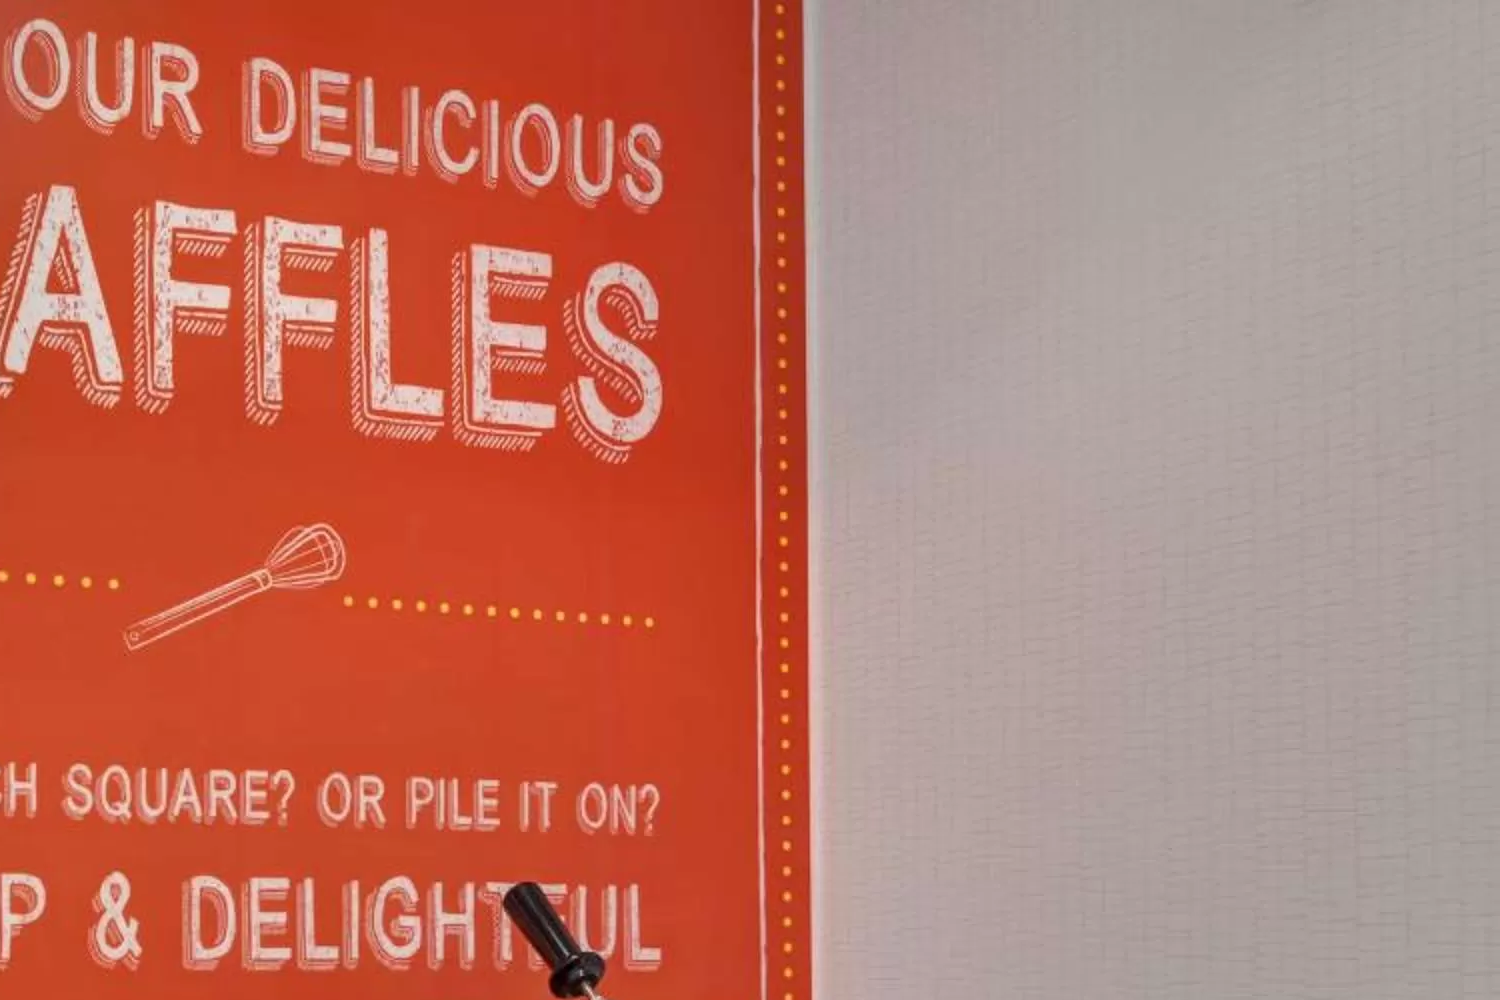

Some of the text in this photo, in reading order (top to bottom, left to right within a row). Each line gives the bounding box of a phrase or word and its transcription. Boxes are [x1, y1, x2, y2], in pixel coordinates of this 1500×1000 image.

[4, 18, 203, 143] OUR
[241, 57, 664, 212] DELICIOUS
[62, 763, 297, 826] SQUARE?
[318, 772, 385, 828] OR
[405, 776, 500, 831] PILE
[519, 779, 557, 833] IT
[575, 782, 662, 837] ON?
[90, 870, 144, 971] &
